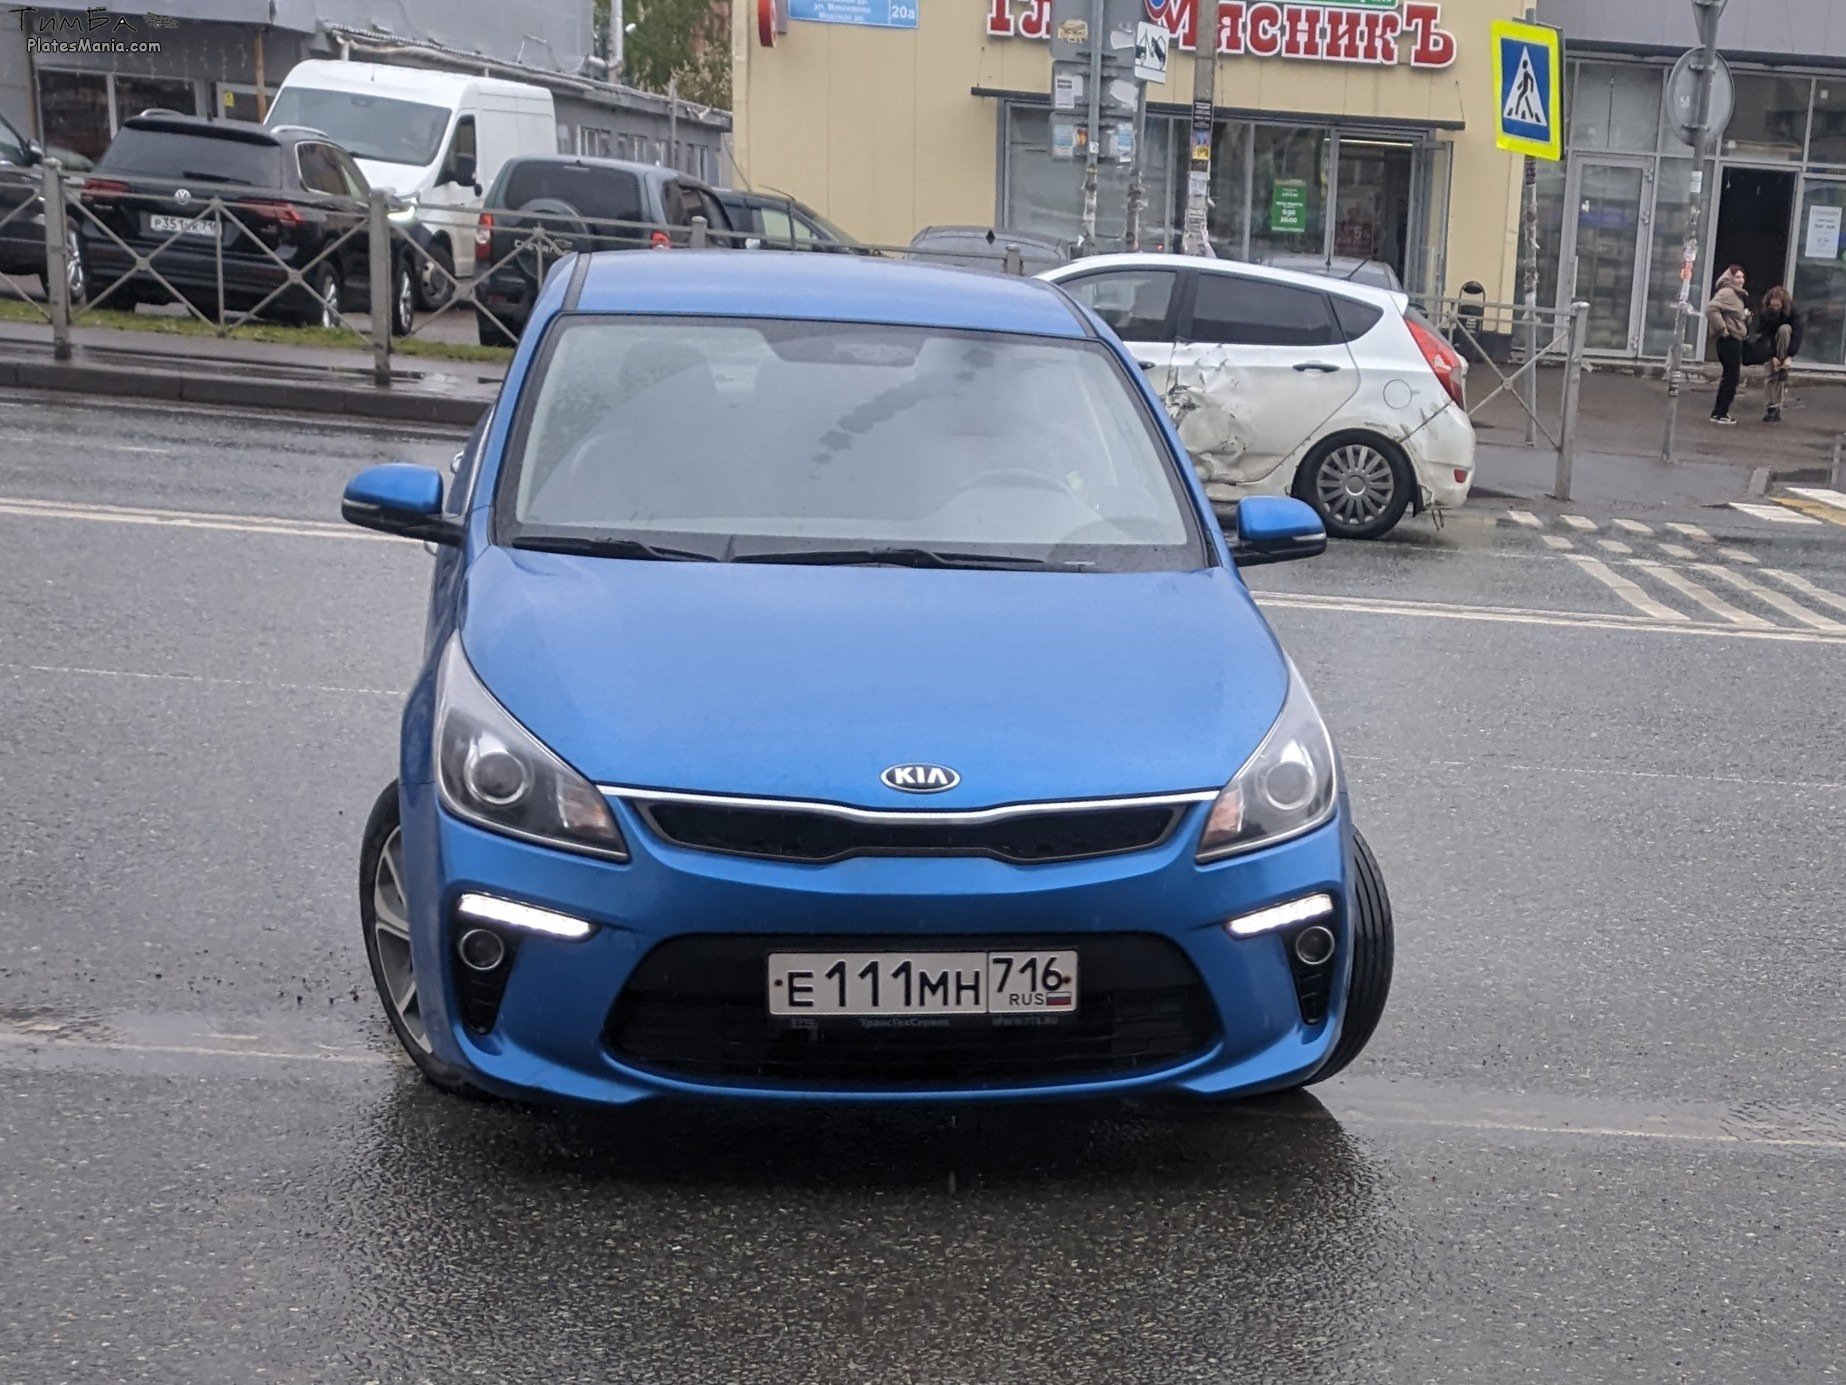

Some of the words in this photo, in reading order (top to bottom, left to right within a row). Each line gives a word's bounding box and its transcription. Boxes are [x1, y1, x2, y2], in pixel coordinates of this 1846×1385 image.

[894, 766, 948, 785] KIA
[992, 957, 1063, 992] 716
[1009, 993, 1044, 1006] RUS
